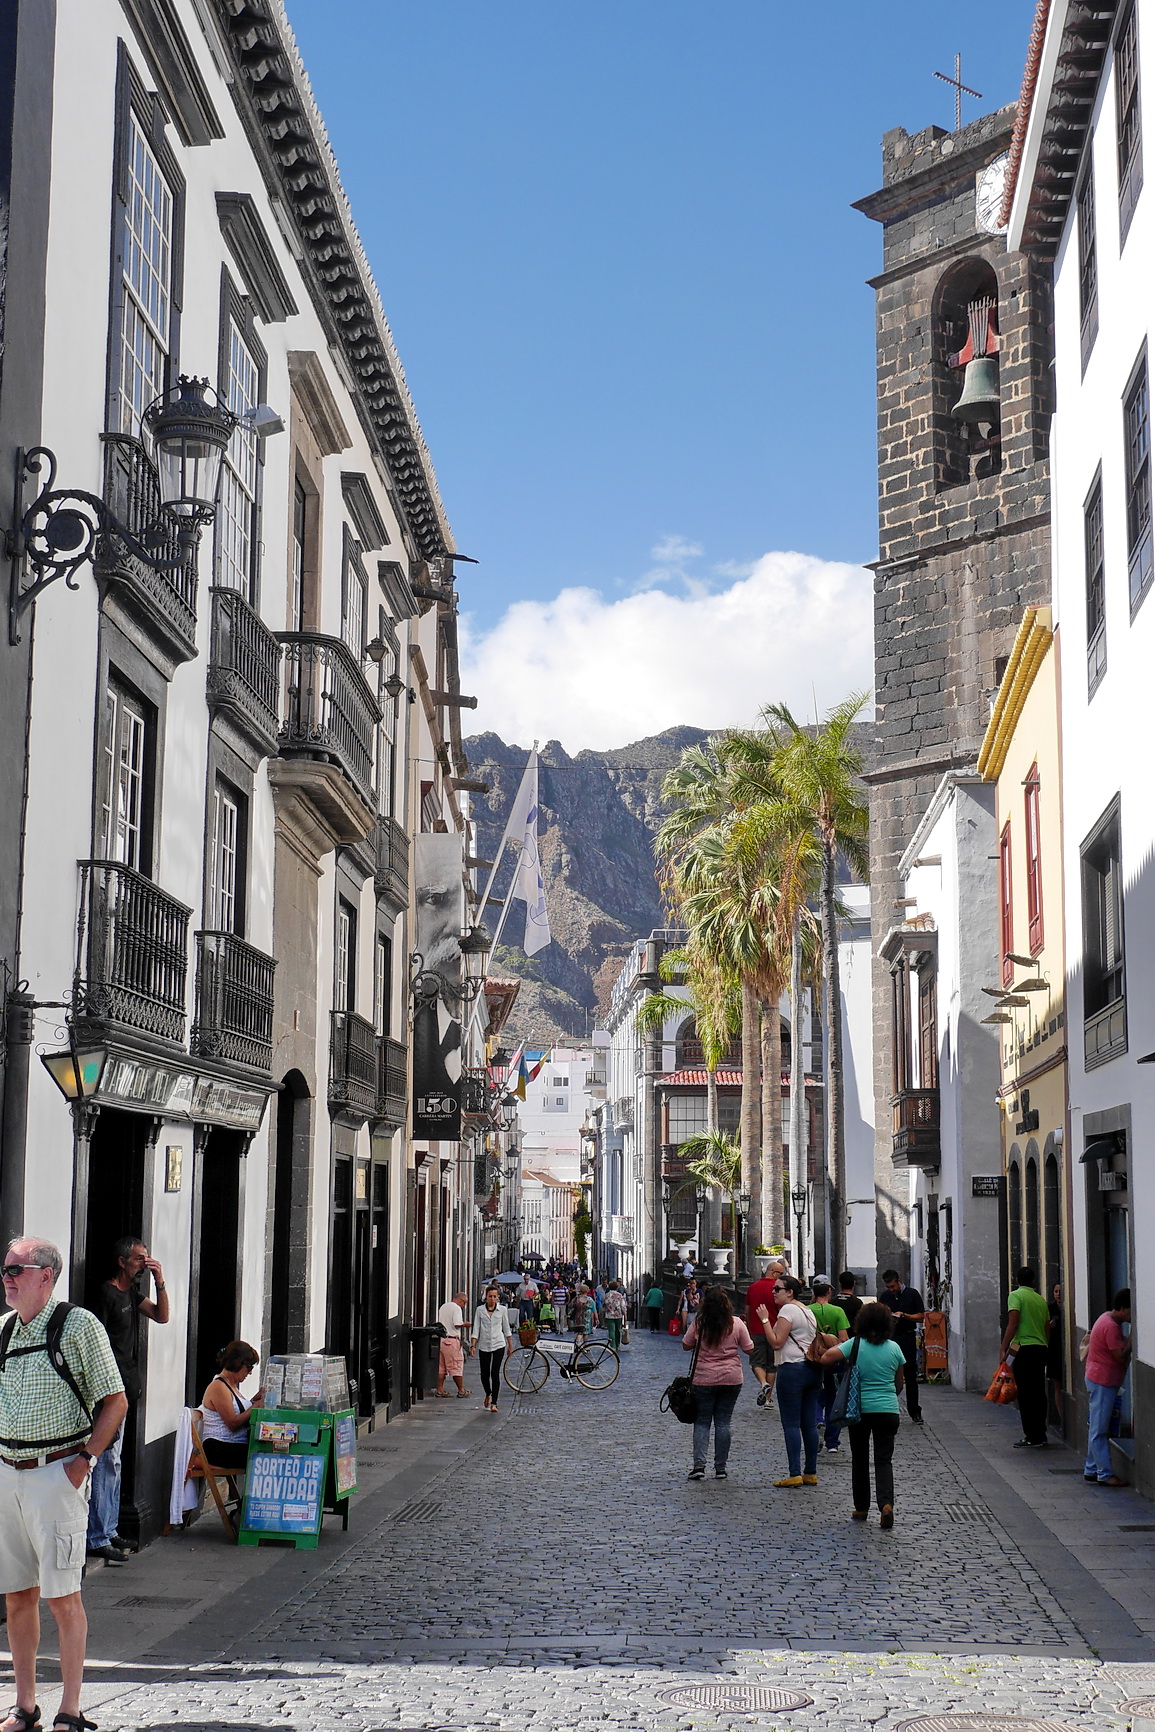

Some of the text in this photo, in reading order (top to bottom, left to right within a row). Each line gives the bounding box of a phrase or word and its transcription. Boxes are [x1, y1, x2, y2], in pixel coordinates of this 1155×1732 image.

[417, 1097, 458, 1114] 150
[254, 1457, 301, 1478] SORTEO
[303, 1460, 320, 1478] DE
[251, 1475, 318, 1502] NAVIDAD
